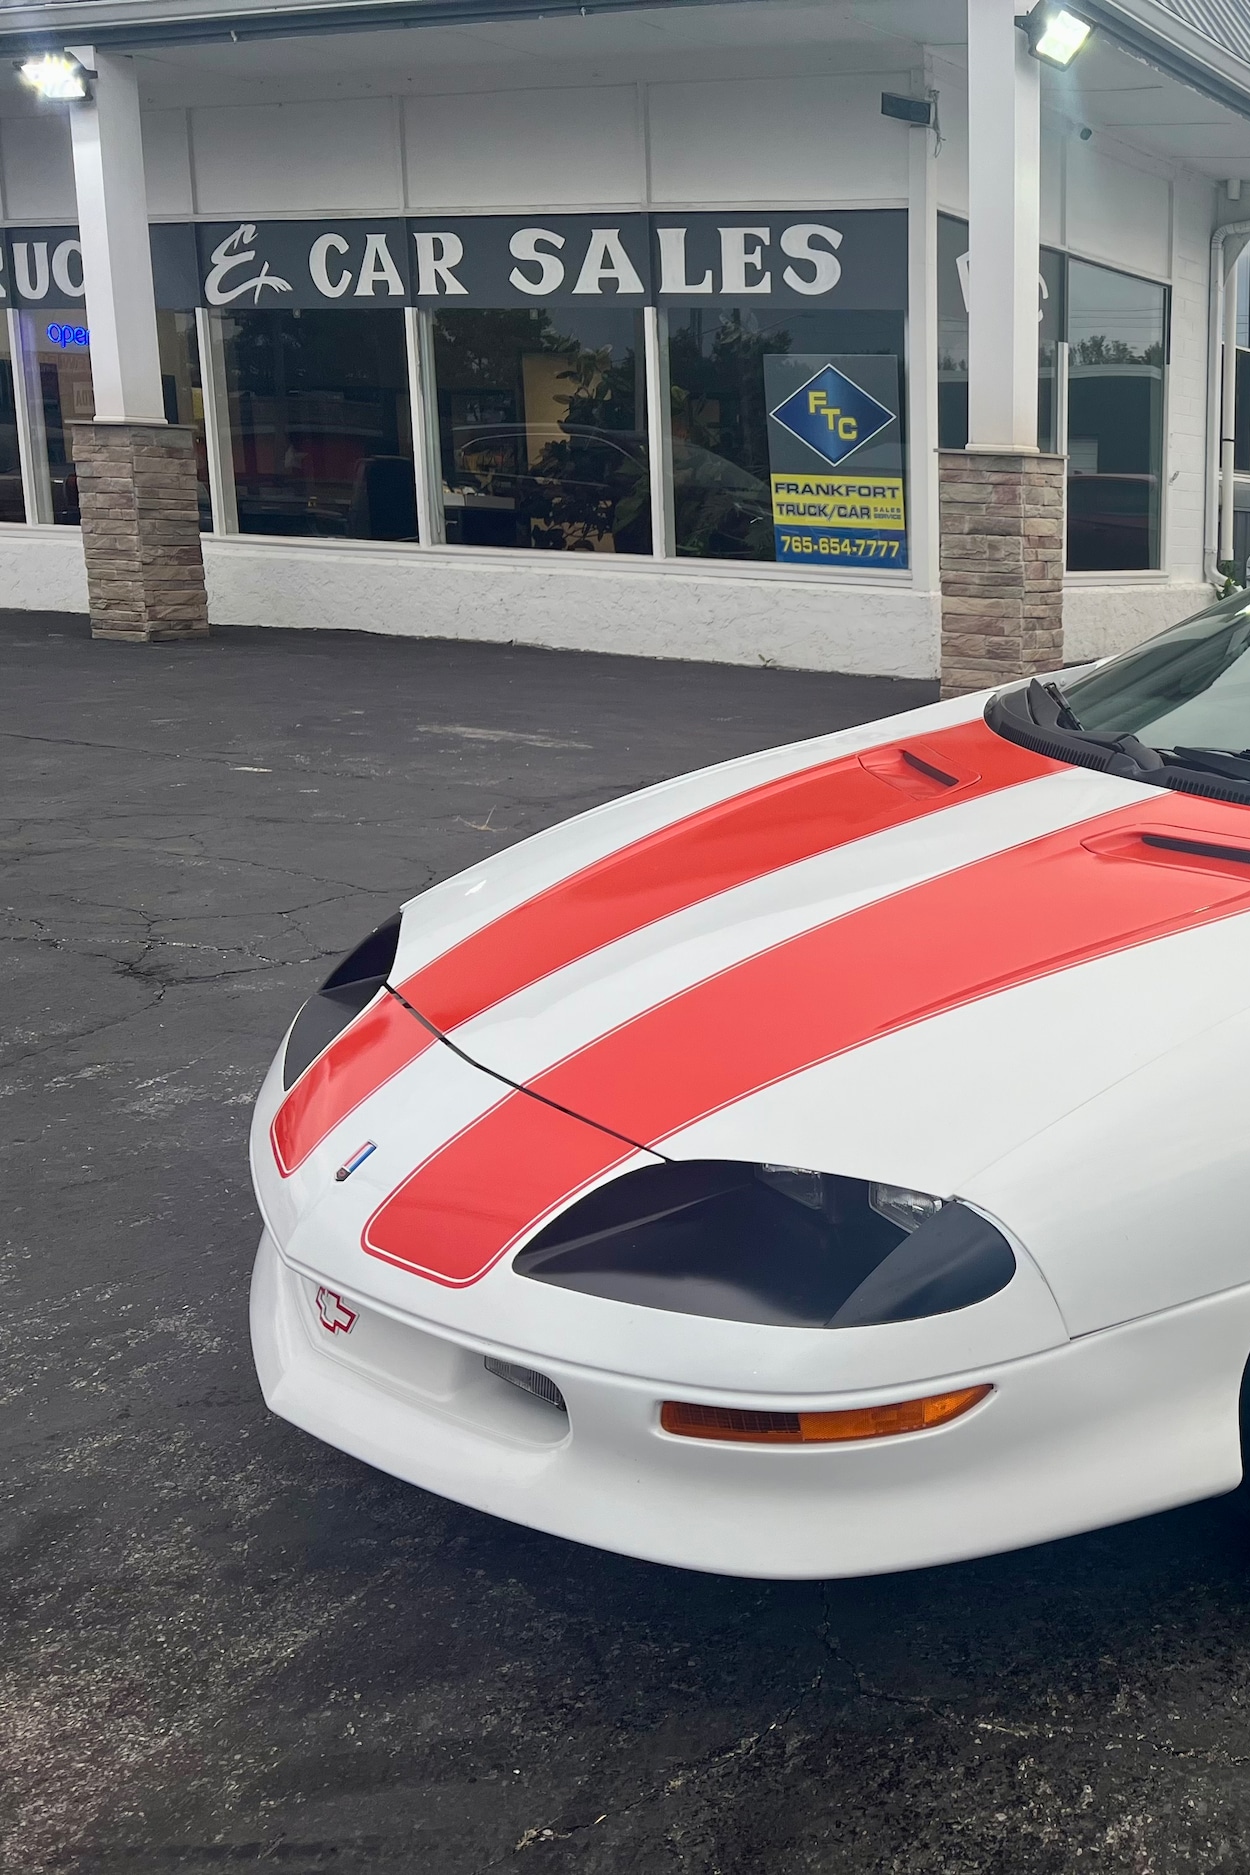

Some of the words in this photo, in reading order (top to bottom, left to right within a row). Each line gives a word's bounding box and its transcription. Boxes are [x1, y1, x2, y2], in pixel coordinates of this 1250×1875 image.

[0, 239, 86, 299] UC
[308, 232, 469, 298] CAR
[508, 223, 844, 295] SALES
[807, 391, 859, 440] FTC
[775, 482, 900, 499] FRANKFORT
[776, 503, 871, 521] TRUCK/CAR
[780, 535, 900, 558] 765-654-7777
